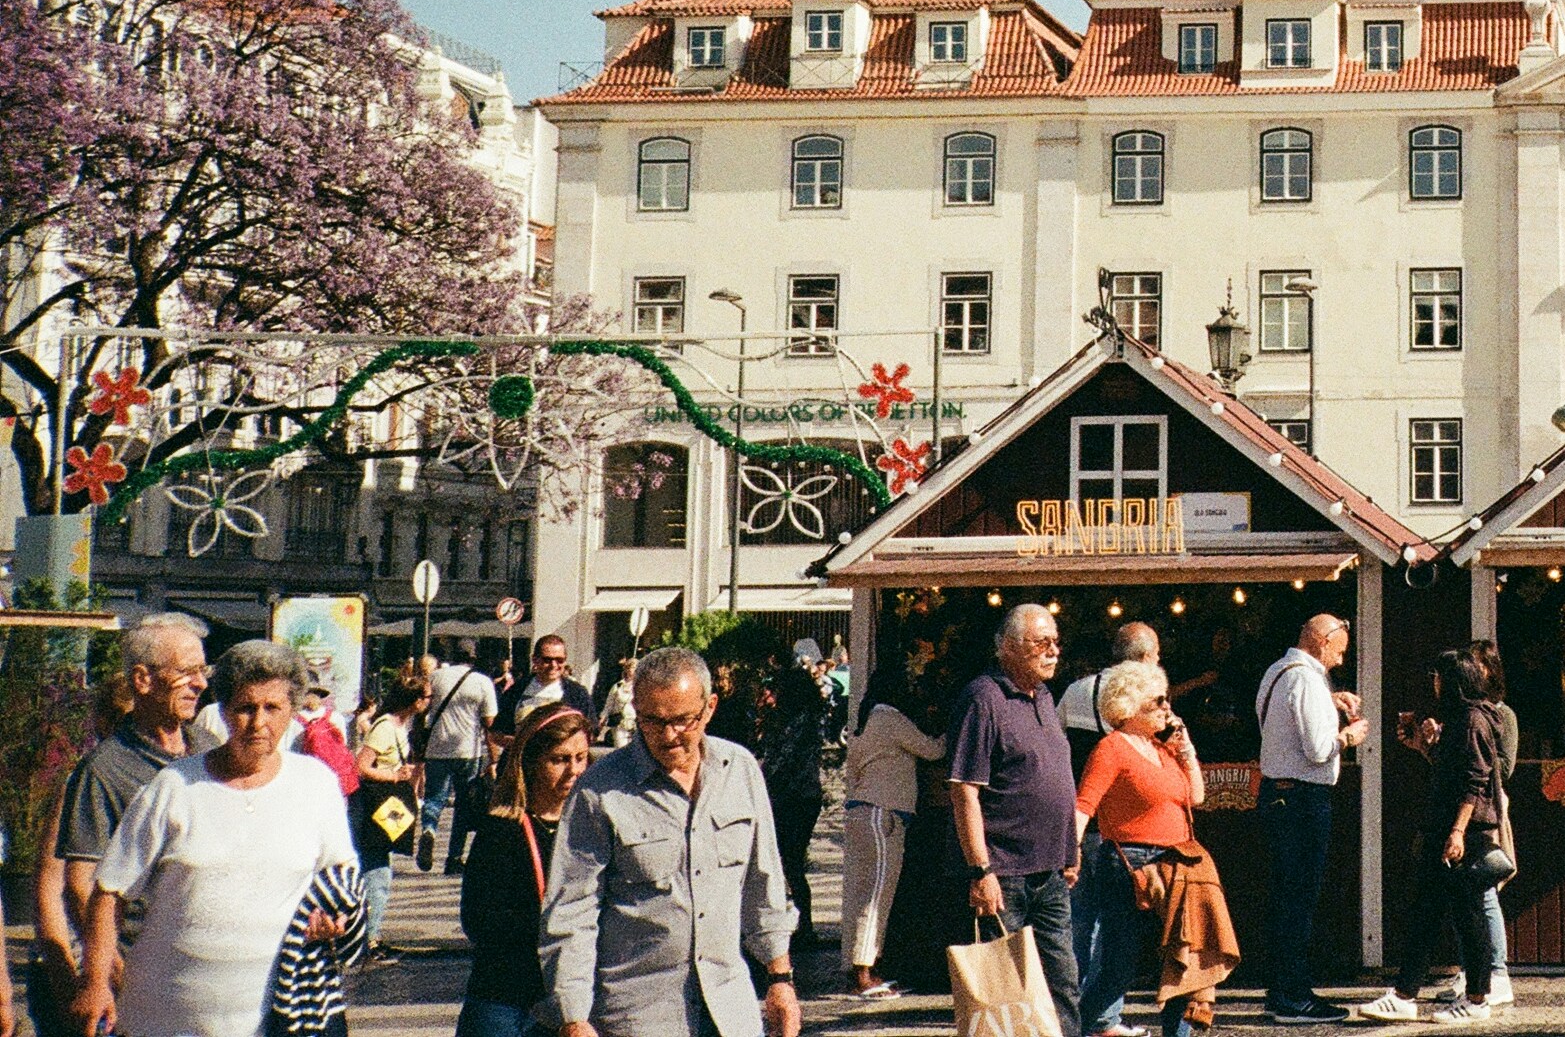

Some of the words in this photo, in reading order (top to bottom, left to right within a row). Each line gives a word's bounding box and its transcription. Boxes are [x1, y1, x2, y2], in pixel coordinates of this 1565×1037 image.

[727, 403, 814, 423] COLORS
[1016, 497, 1186, 557] SANGRIA
[1202, 768, 1250, 784] SANGRIA
